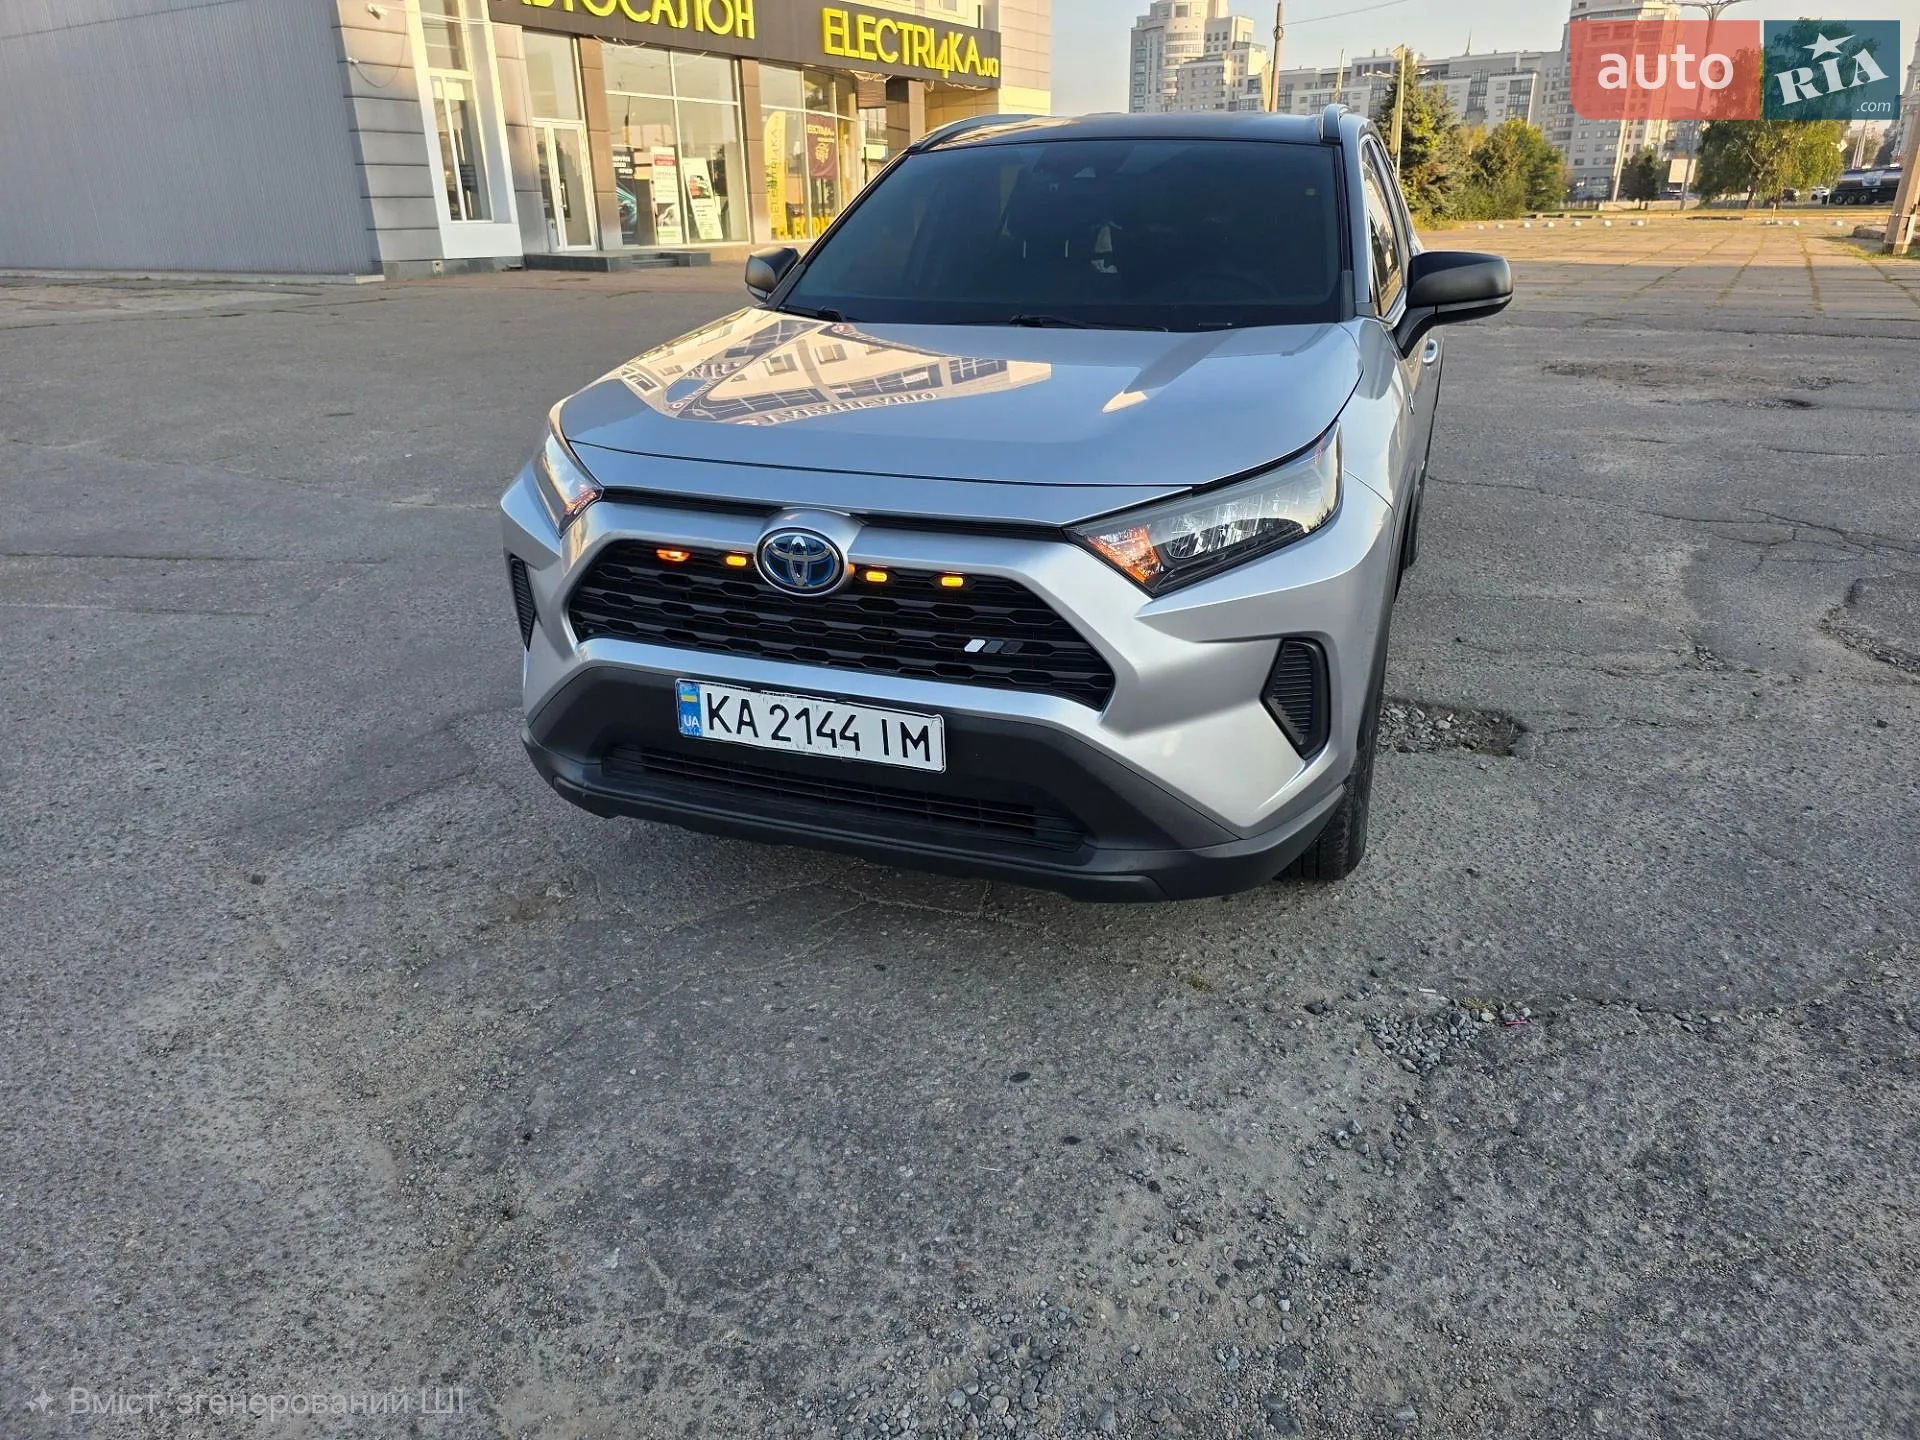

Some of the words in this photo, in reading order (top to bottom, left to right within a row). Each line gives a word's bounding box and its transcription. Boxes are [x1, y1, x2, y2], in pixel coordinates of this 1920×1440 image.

[521, 0, 755, 39] САЛОН
[683, 714, 700, 728] UA
[707, 693, 759, 737] KA
[769, 704, 861, 751] 2144
[881, 719, 931, 762] IM
